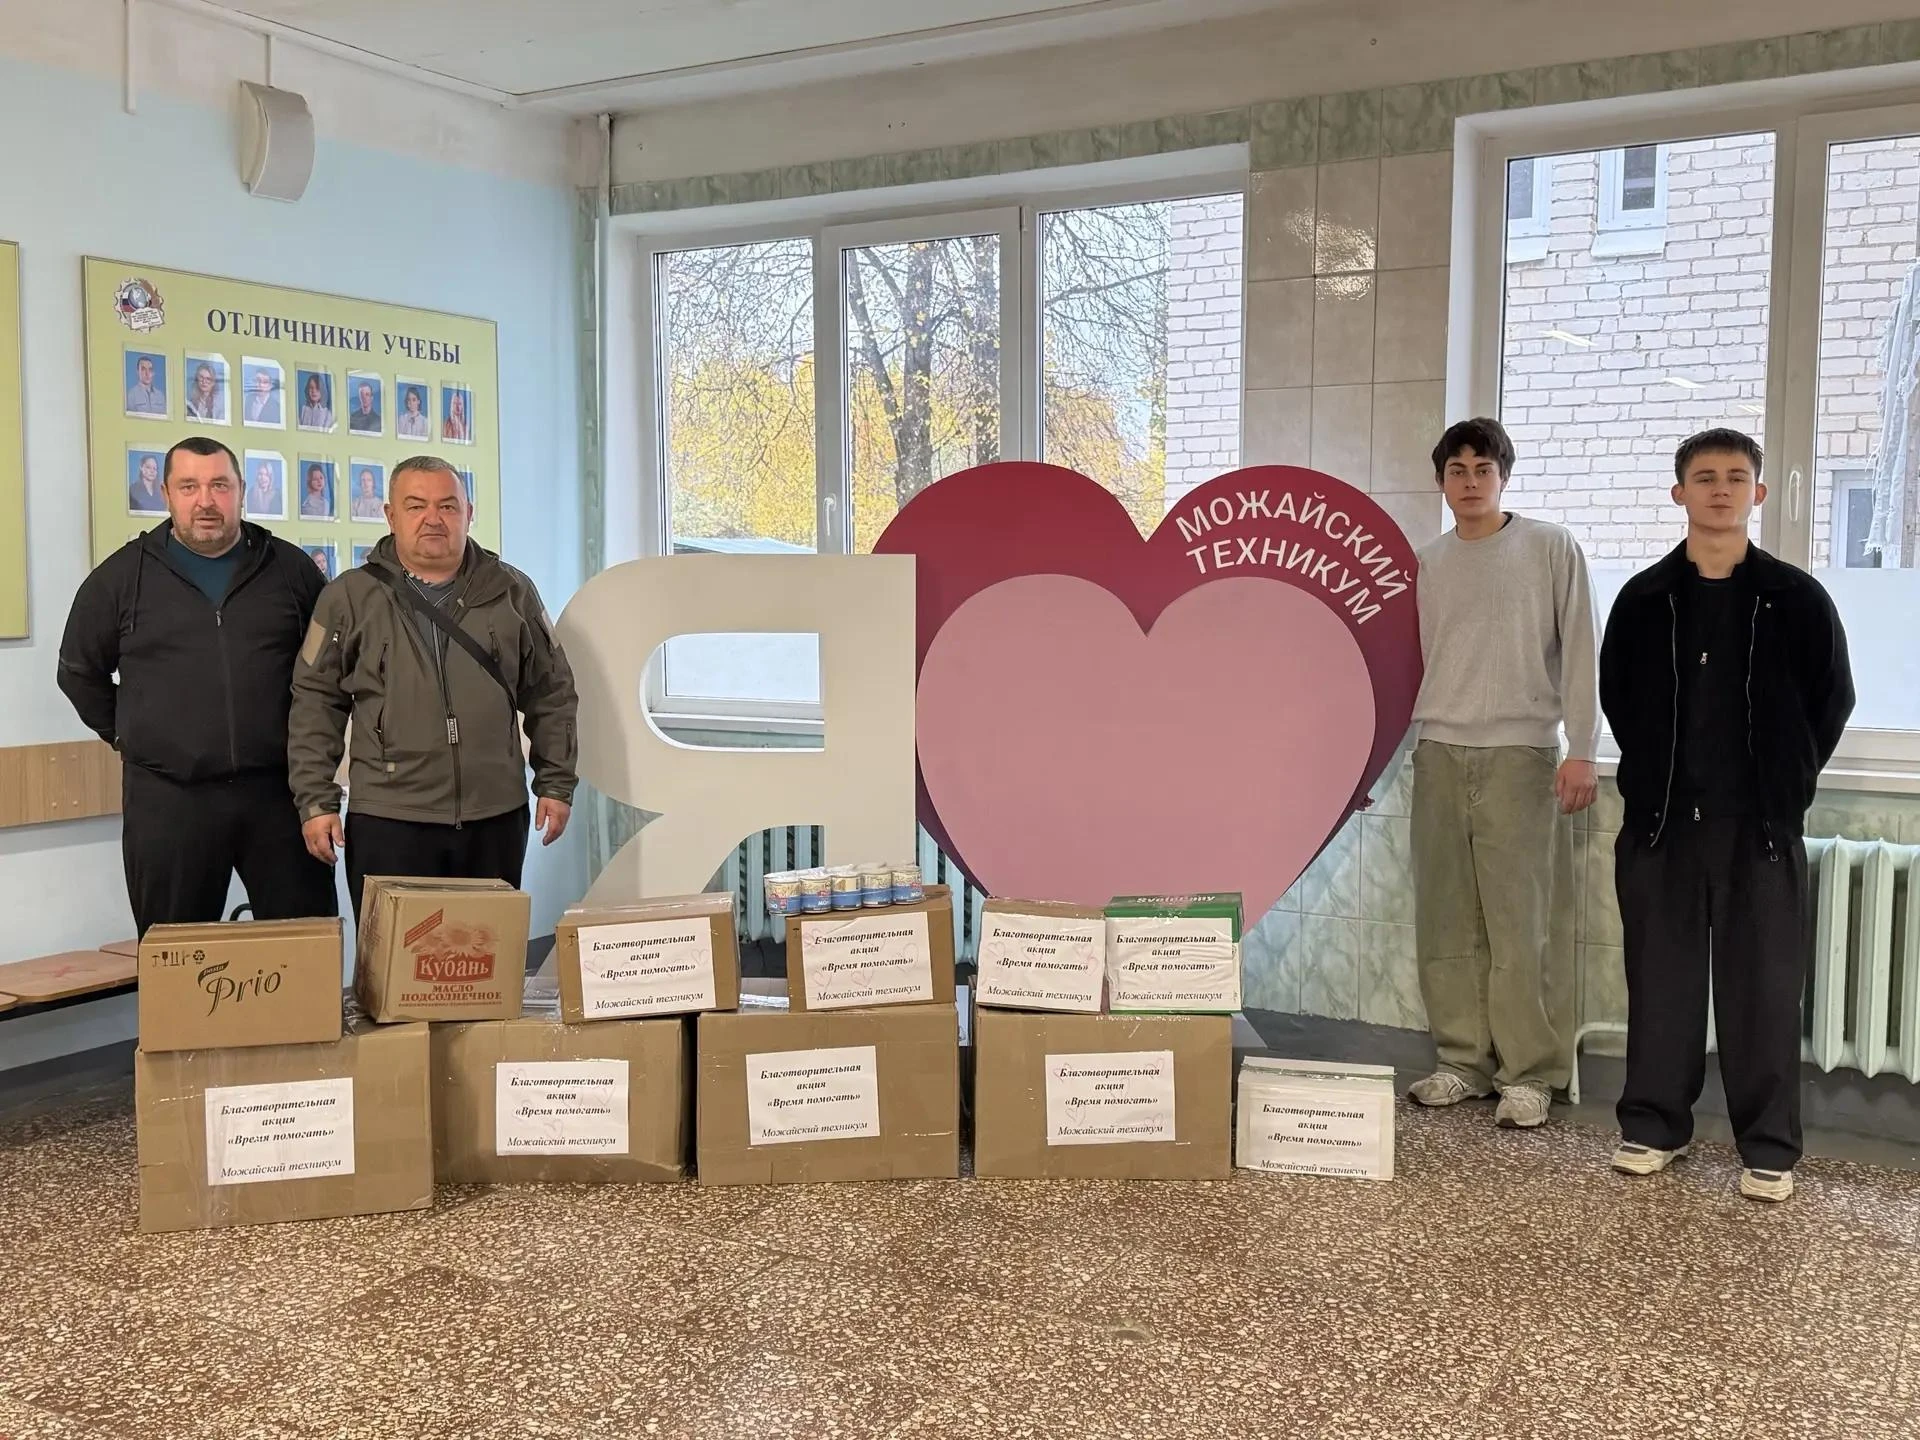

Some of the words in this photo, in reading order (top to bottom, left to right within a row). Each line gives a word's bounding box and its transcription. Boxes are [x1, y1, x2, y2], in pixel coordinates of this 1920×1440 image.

[207, 309, 372, 353] ОТЛИЧНИКИ
[382, 333, 462, 365] УЧЕБЫ
[1175, 489, 1412, 600] МОЖАЙСКИЙ
[1186, 537, 1382, 625] ТЕХНИКУМ
[555, 553, 917, 904] Я
[993, 928, 1092, 942] Благотворительная
[1116, 934, 1217, 945] Благотворительная
[593, 934, 696, 951] Благотворительная
[630, 952, 660, 961] акция
[850, 946, 879, 955] акция
[1027, 946, 1056, 955] акция
[1151, 949, 1181, 957] акция
[420, 952, 490, 981] Кубань
[822, 961, 857, 973] «Время
[860, 957, 914, 969] помогать»
[996, 957, 1032, 969] «Время
[1034, 962, 1089, 971] помогать»
[1122, 962, 1159, 972] «Время
[1161, 963, 1216, 971] помогать»
[600, 968, 637, 981] «Время
[640, 964, 696, 976] помогать»
[206, 969, 281, 1017] Prio
[432, 984, 474, 993] МАСЛО
[817, 988, 873, 1001] Можайский
[875, 985, 921, 995] техникум
[987, 985, 1043, 998] Можайский
[1045, 991, 1092, 1003] техникум
[401, 991, 503, 1002] ПОДСОЛНЕЧНОЕ
[595, 995, 653, 1010] Можайский
[656, 992, 704, 1003] техникум
[1116, 990, 1173, 1001] Можайский
[1175, 992, 1222, 1002] техникум
[761, 1064, 861, 1080] Благотворительная
[1060, 1068, 1160, 1078] Благотворительная
[511, 1077, 614, 1088] Благотворительная
[797, 1081, 826, 1090] акция
[1095, 1082, 1125, 1091] акция
[546, 1092, 577, 1101] акция
[767, 1097, 804, 1108] «Время
[806, 1093, 861, 1104] помогать»
[1065, 1096, 1101, 1107] «Время
[1104, 1096, 1158, 1105] помогать»
[221, 1097, 336, 1115] Благотворительная
[515, 1106, 553, 1118] «Время
[555, 1107, 611, 1115] помогать»
[1263, 1103, 1364, 1120] Благотворительная
[262, 1116, 296, 1126] акция
[1297, 1121, 1328, 1131] акция
[762, 1125, 819, 1138] Можайский
[821, 1121, 868, 1132] техникум
[1058, 1125, 1114, 1136] Можайский
[1116, 1125, 1163, 1134] техникум
[228, 1134, 270, 1147] «Время
[272, 1129, 335, 1141] помогать»
[507, 1136, 566, 1147] Можайский
[568, 1137, 616, 1147] техникум
[1267, 1132, 1304, 1144] «Время
[1306, 1136, 1362, 1147] помогать»
[220, 1162, 286, 1178] Можайский
[288, 1159, 342, 1171] техникум
[1260, 1159, 1317, 1173] Можайский
[1320, 1166, 1368, 1176] техникум
